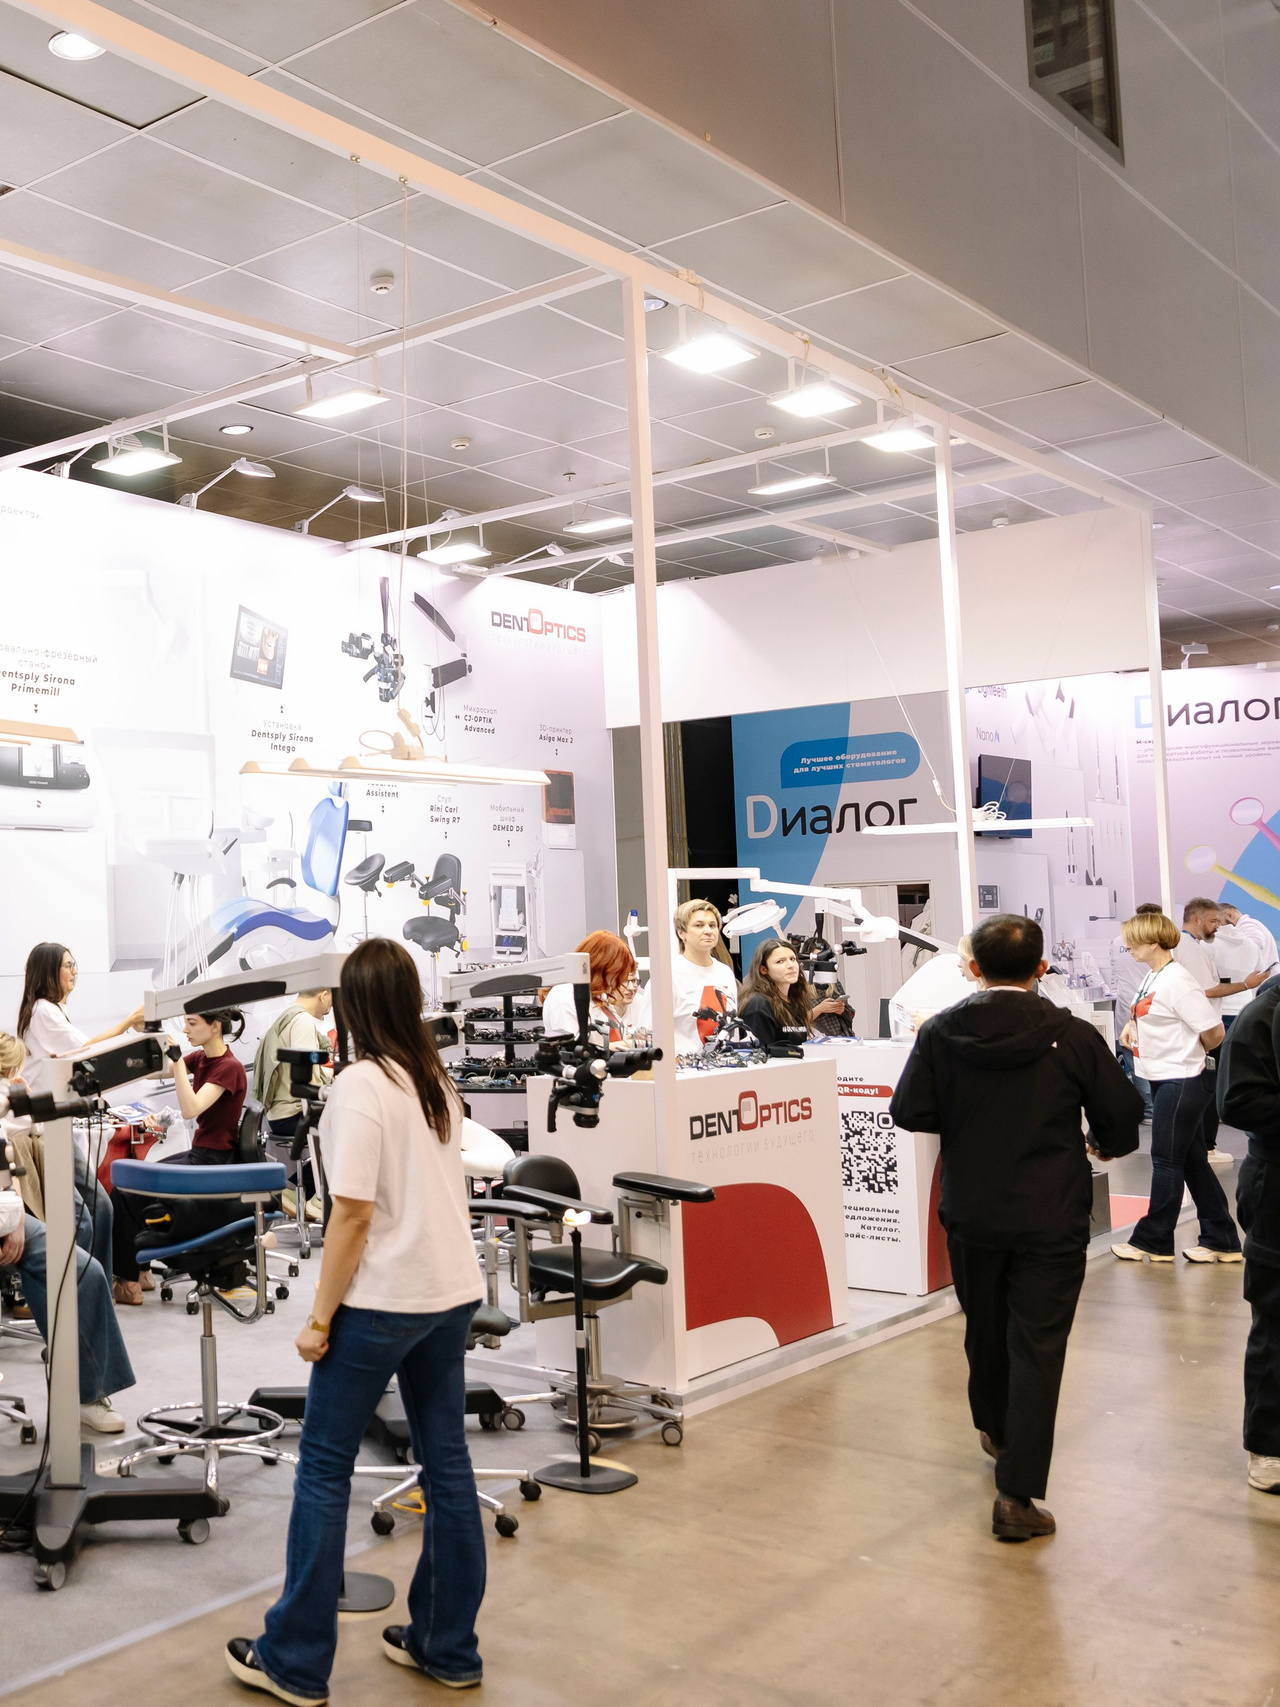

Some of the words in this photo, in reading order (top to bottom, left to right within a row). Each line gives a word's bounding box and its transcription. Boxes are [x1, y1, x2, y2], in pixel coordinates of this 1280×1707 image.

[18, 659, 52, 670] станок
[43, 673, 76, 686] Sirona
[11, 683, 61, 697] Primemill
[463, 705, 498, 715] Микроскоп
[263, 719, 302, 731] Установка
[464, 724, 496, 735] Advanced
[251, 729, 287, 742] Dentsply
[289, 732, 314, 743] Sirona
[270, 742, 296, 754] Intego
[801, 756, 834, 765] Лучшее
[835, 750, 898, 762] оборудование
[793, 766, 810, 774] для
[811, 763, 844, 773] лучших
[846, 758, 907, 769] стоматологов
[365, 789, 399, 798] Assistent
[437, 794, 452, 804] Стул
[429, 804, 443, 813] Rini
[444, 805, 459, 814] Carl
[490, 804, 525, 813] Мобильный
[430, 815, 450, 825] Swing
[452, 816, 461, 825] R7
[500, 815, 516, 823] шкаф
[492, 823, 514, 832] DEMED
[837, 1086, 879, 1096] QR-коду!
[691, 1139, 760, 1165] технологии
[764, 1129, 815, 1152] будущего
[843, 1205, 900, 1214] пециальные
[845, 1214, 900, 1224] едложения.
[860, 1224, 901, 1233] Каталог.
[844, 1232, 901, 1242] райс-листы.
